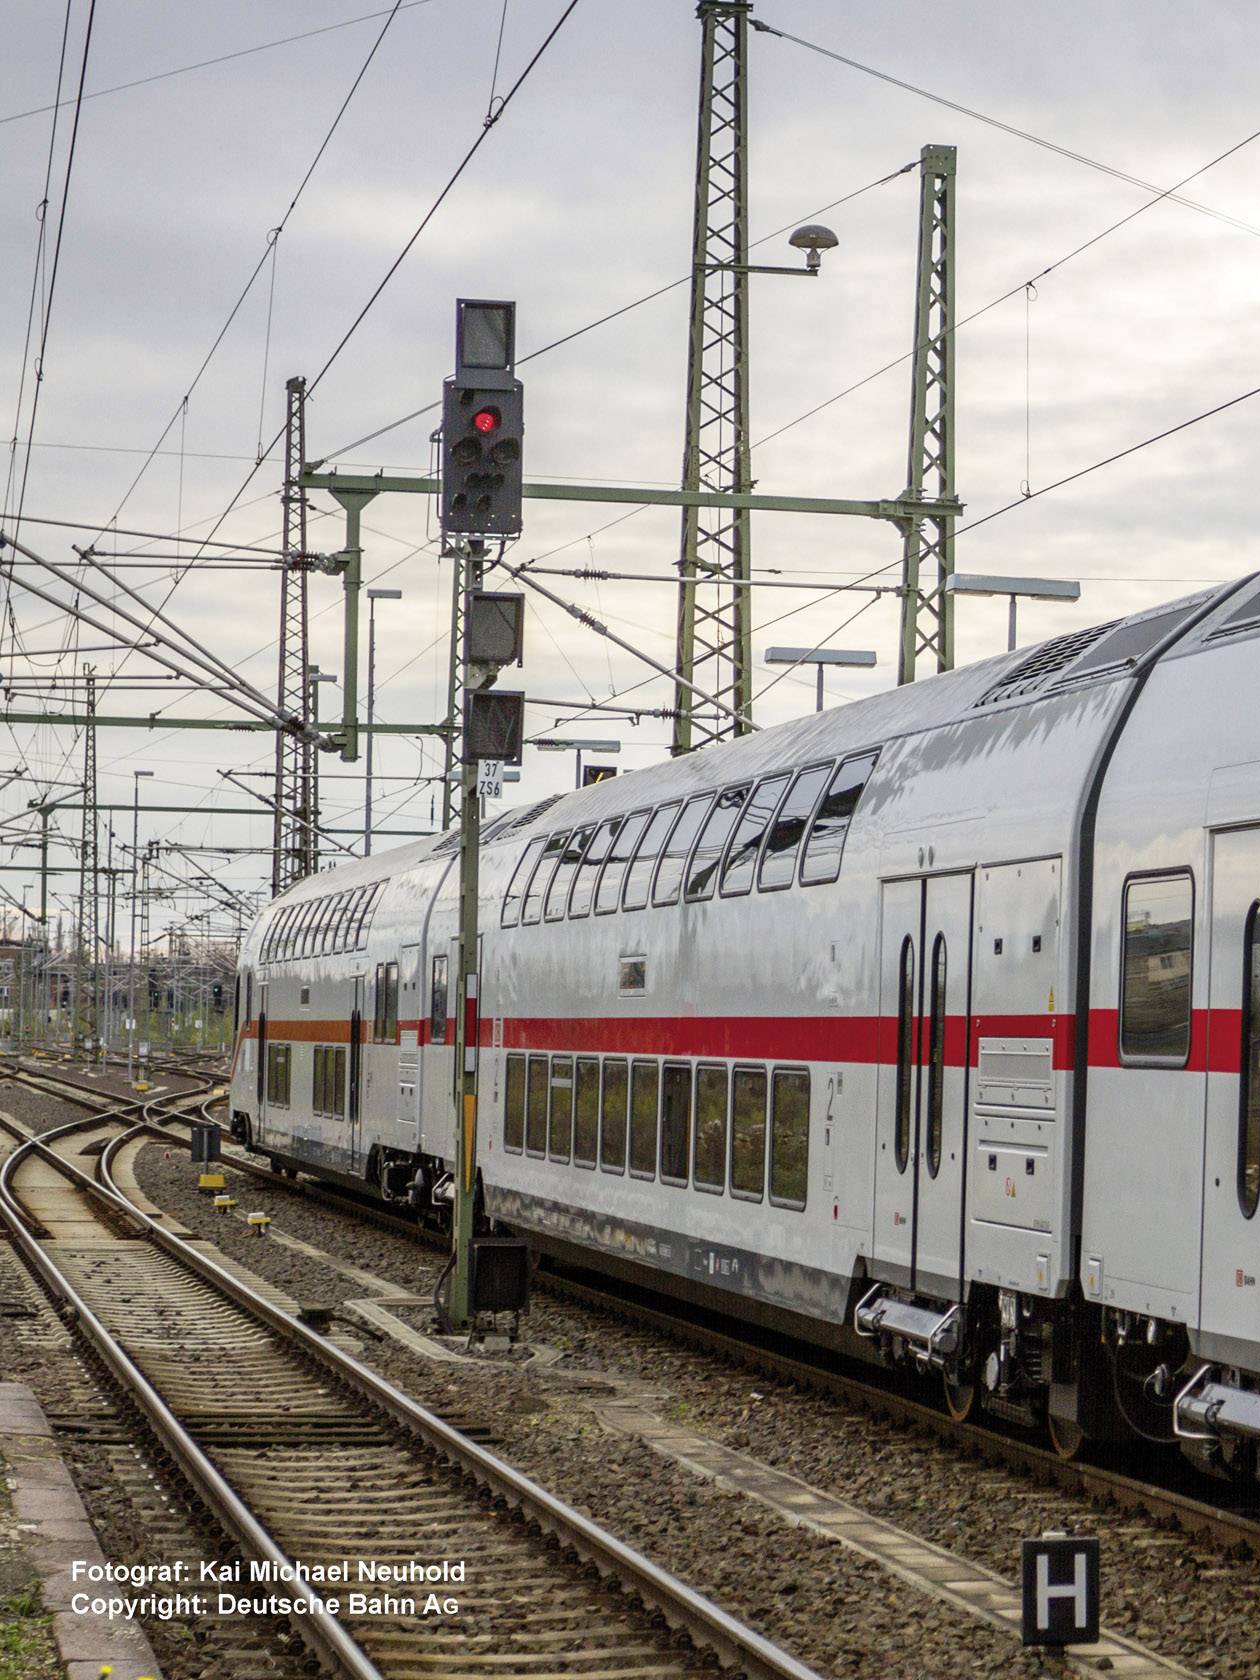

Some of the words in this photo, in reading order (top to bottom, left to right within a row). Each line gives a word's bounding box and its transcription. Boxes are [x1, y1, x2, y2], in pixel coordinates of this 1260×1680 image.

[484, 763, 498, 777] 37
[479, 781, 500, 796] ZS6
[827, 1077, 834, 1121] 2
[1037, 1553, 1087, 1629] H
